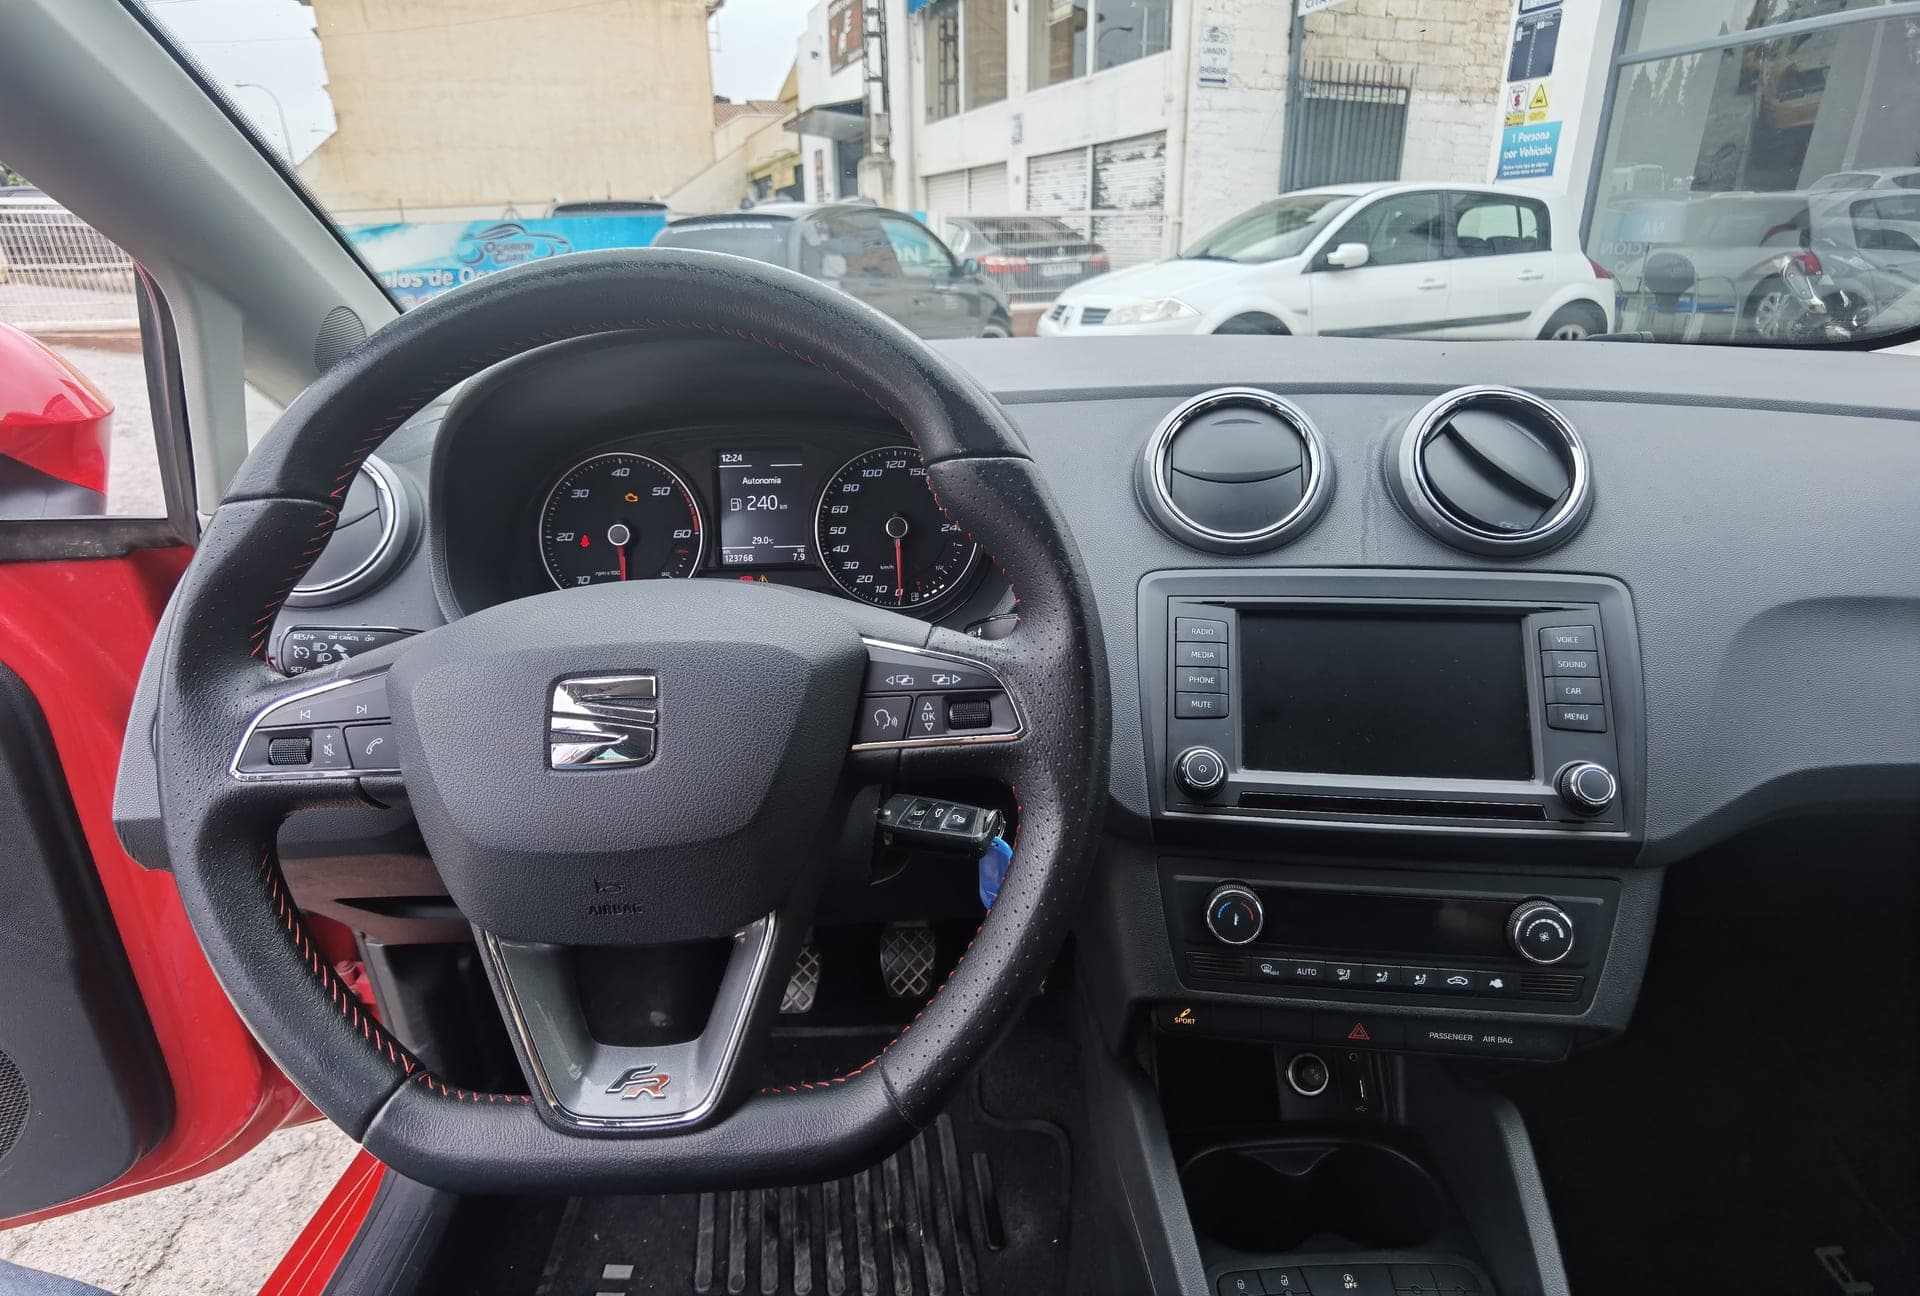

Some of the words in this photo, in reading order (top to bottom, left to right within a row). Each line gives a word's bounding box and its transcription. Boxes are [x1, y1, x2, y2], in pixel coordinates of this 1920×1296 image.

[1511, 134, 1517, 145] 1
[1518, 131, 1550, 143] Persona
[428, 268, 454, 287] de
[721, 454, 743, 462] 12:24
[885, 460, 907, 469] 120
[611, 467, 631, 477] 40
[861, 469, 883, 477] 100
[742, 476, 782, 485] Autonomía
[651, 486, 671, 496] 50
[842, 484, 859, 492] 80
[570, 489, 590, 498] 30
[746, 494, 778, 511] 240
[831, 505, 848, 514] 60
[829, 526, 847, 535] 50
[940, 523, 961, 532] 24
[556, 532, 575, 542] 20
[673, 529, 691, 539] 60
[832, 545, 850, 553] 40
[724, 554, 754, 562] 123768
[792, 552, 806, 561] 7.9
[842, 561, 859, 570] 30
[575, 575, 590, 585] 10
[856, 574, 873, 583] 20
[874, 585, 888, 593] 10
[1191, 628, 1214, 636] RADIO
[1556, 636, 1580, 644] VOICE
[1191, 651, 1215, 659] MEDIA
[1557, 660, 1587, 669] SOUND
[1188, 675, 1216, 685] PHONE
[1565, 687, 1582, 695] CAR
[1191, 700, 1213, 709] MUTE
[921, 712, 936, 721] OK
[1564, 712, 1589, 721] MENU
[588, 903, 643, 917] AIRBAG
[1296, 968, 1317, 976] AUTO
[1174, 1017, 1196, 1025] SPORT
[1429, 1031, 1473, 1042] PASSENGER
[1482, 1035, 1496, 1043] AIR
[1497, 1036, 1513, 1044] BAG
